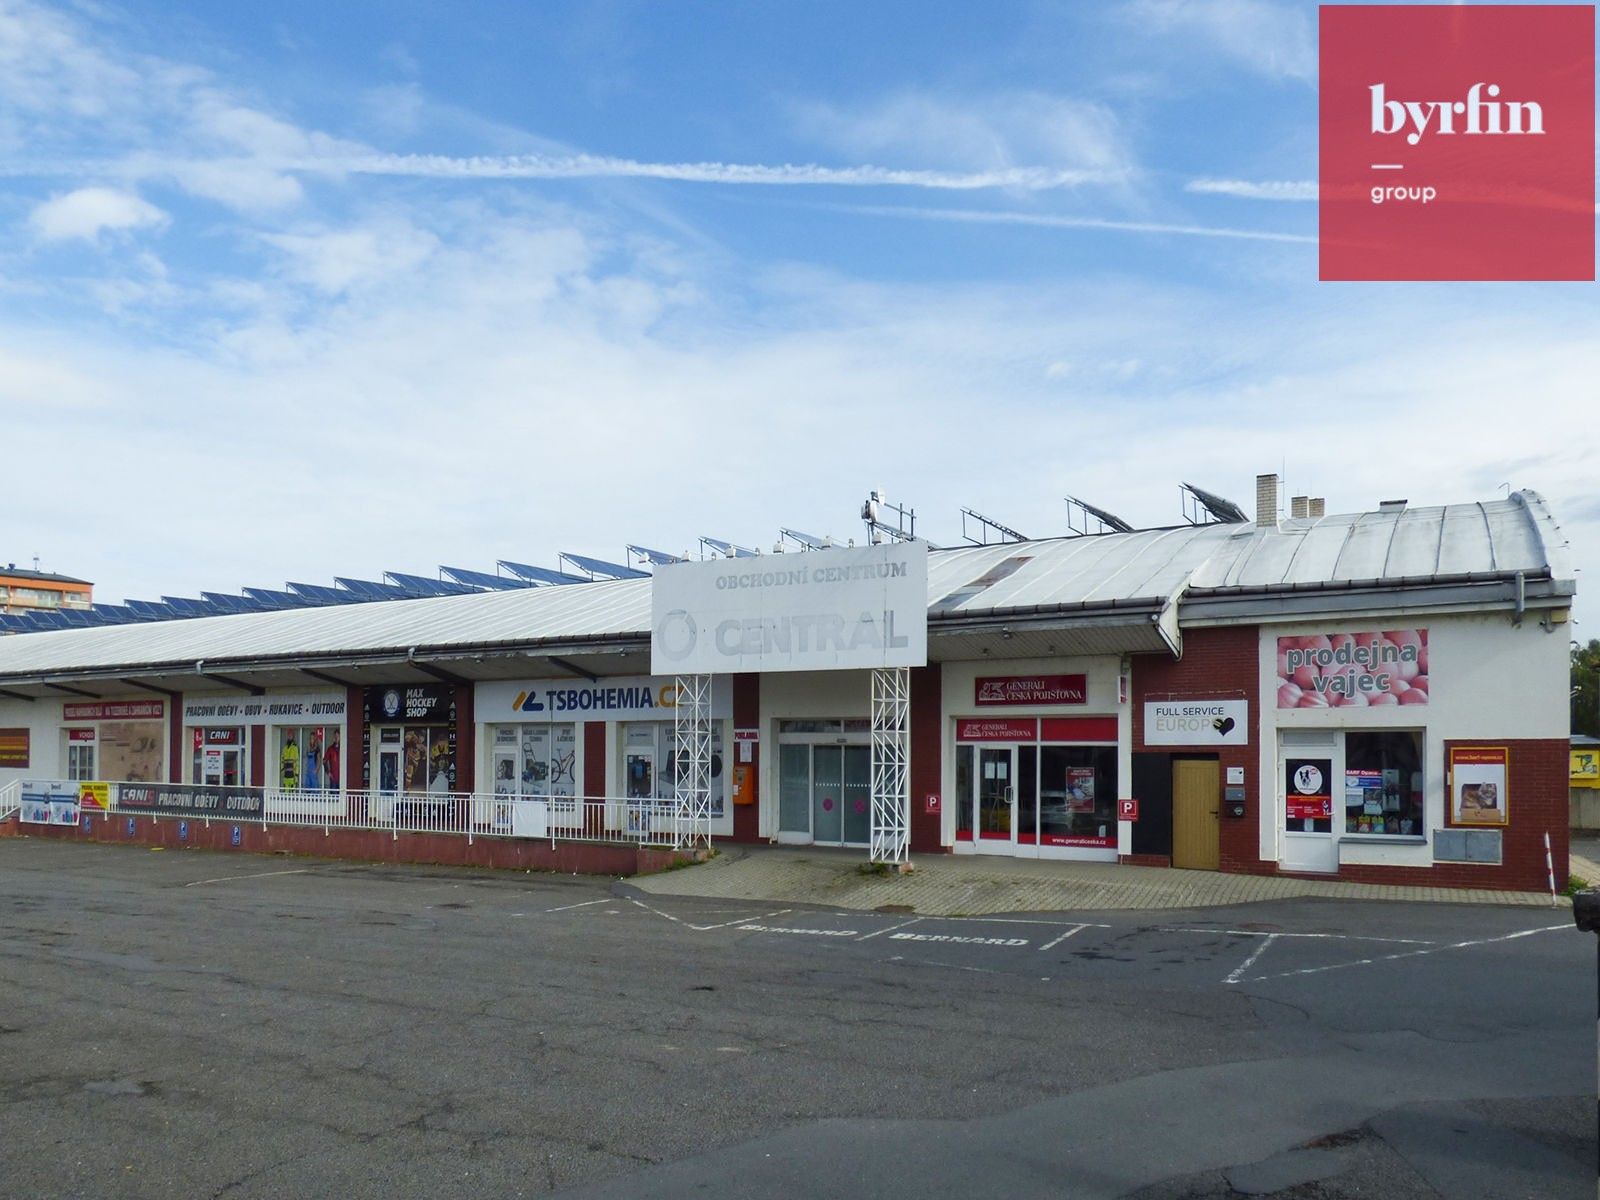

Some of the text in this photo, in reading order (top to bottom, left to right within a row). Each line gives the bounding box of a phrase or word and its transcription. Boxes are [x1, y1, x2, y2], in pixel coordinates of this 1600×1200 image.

[715, 561, 908, 591] OBCHODNÍ CENTRUM
[714, 608, 909, 657] CENTRAL
[1287, 640, 1418, 674] prodejna
[1005, 680, 1046, 690] GENERALI
[1312, 669, 1390, 699] vajec
[405, 688, 425, 698] MAX
[185, 704, 216, 717] PRACOVNÍ
[244, 705, 262, 716] OBUV
[268, 703, 303, 715] RUKAVICE
[311, 702, 345, 715] OUTDOOR
[405, 698, 438, 708] HOCKEY
[405, 707, 428, 718] SHOP
[1156, 706, 1225, 716] FULL SERVICE
[158, 792, 194, 808] PRACOVNÍ
[194, 794, 220, 809] ODĚVY
[928, 796, 937, 808] P
[1123, 801, 1133, 814] P
[231, 825, 239, 837] P
[887, 932, 1030, 946] BERNARD
